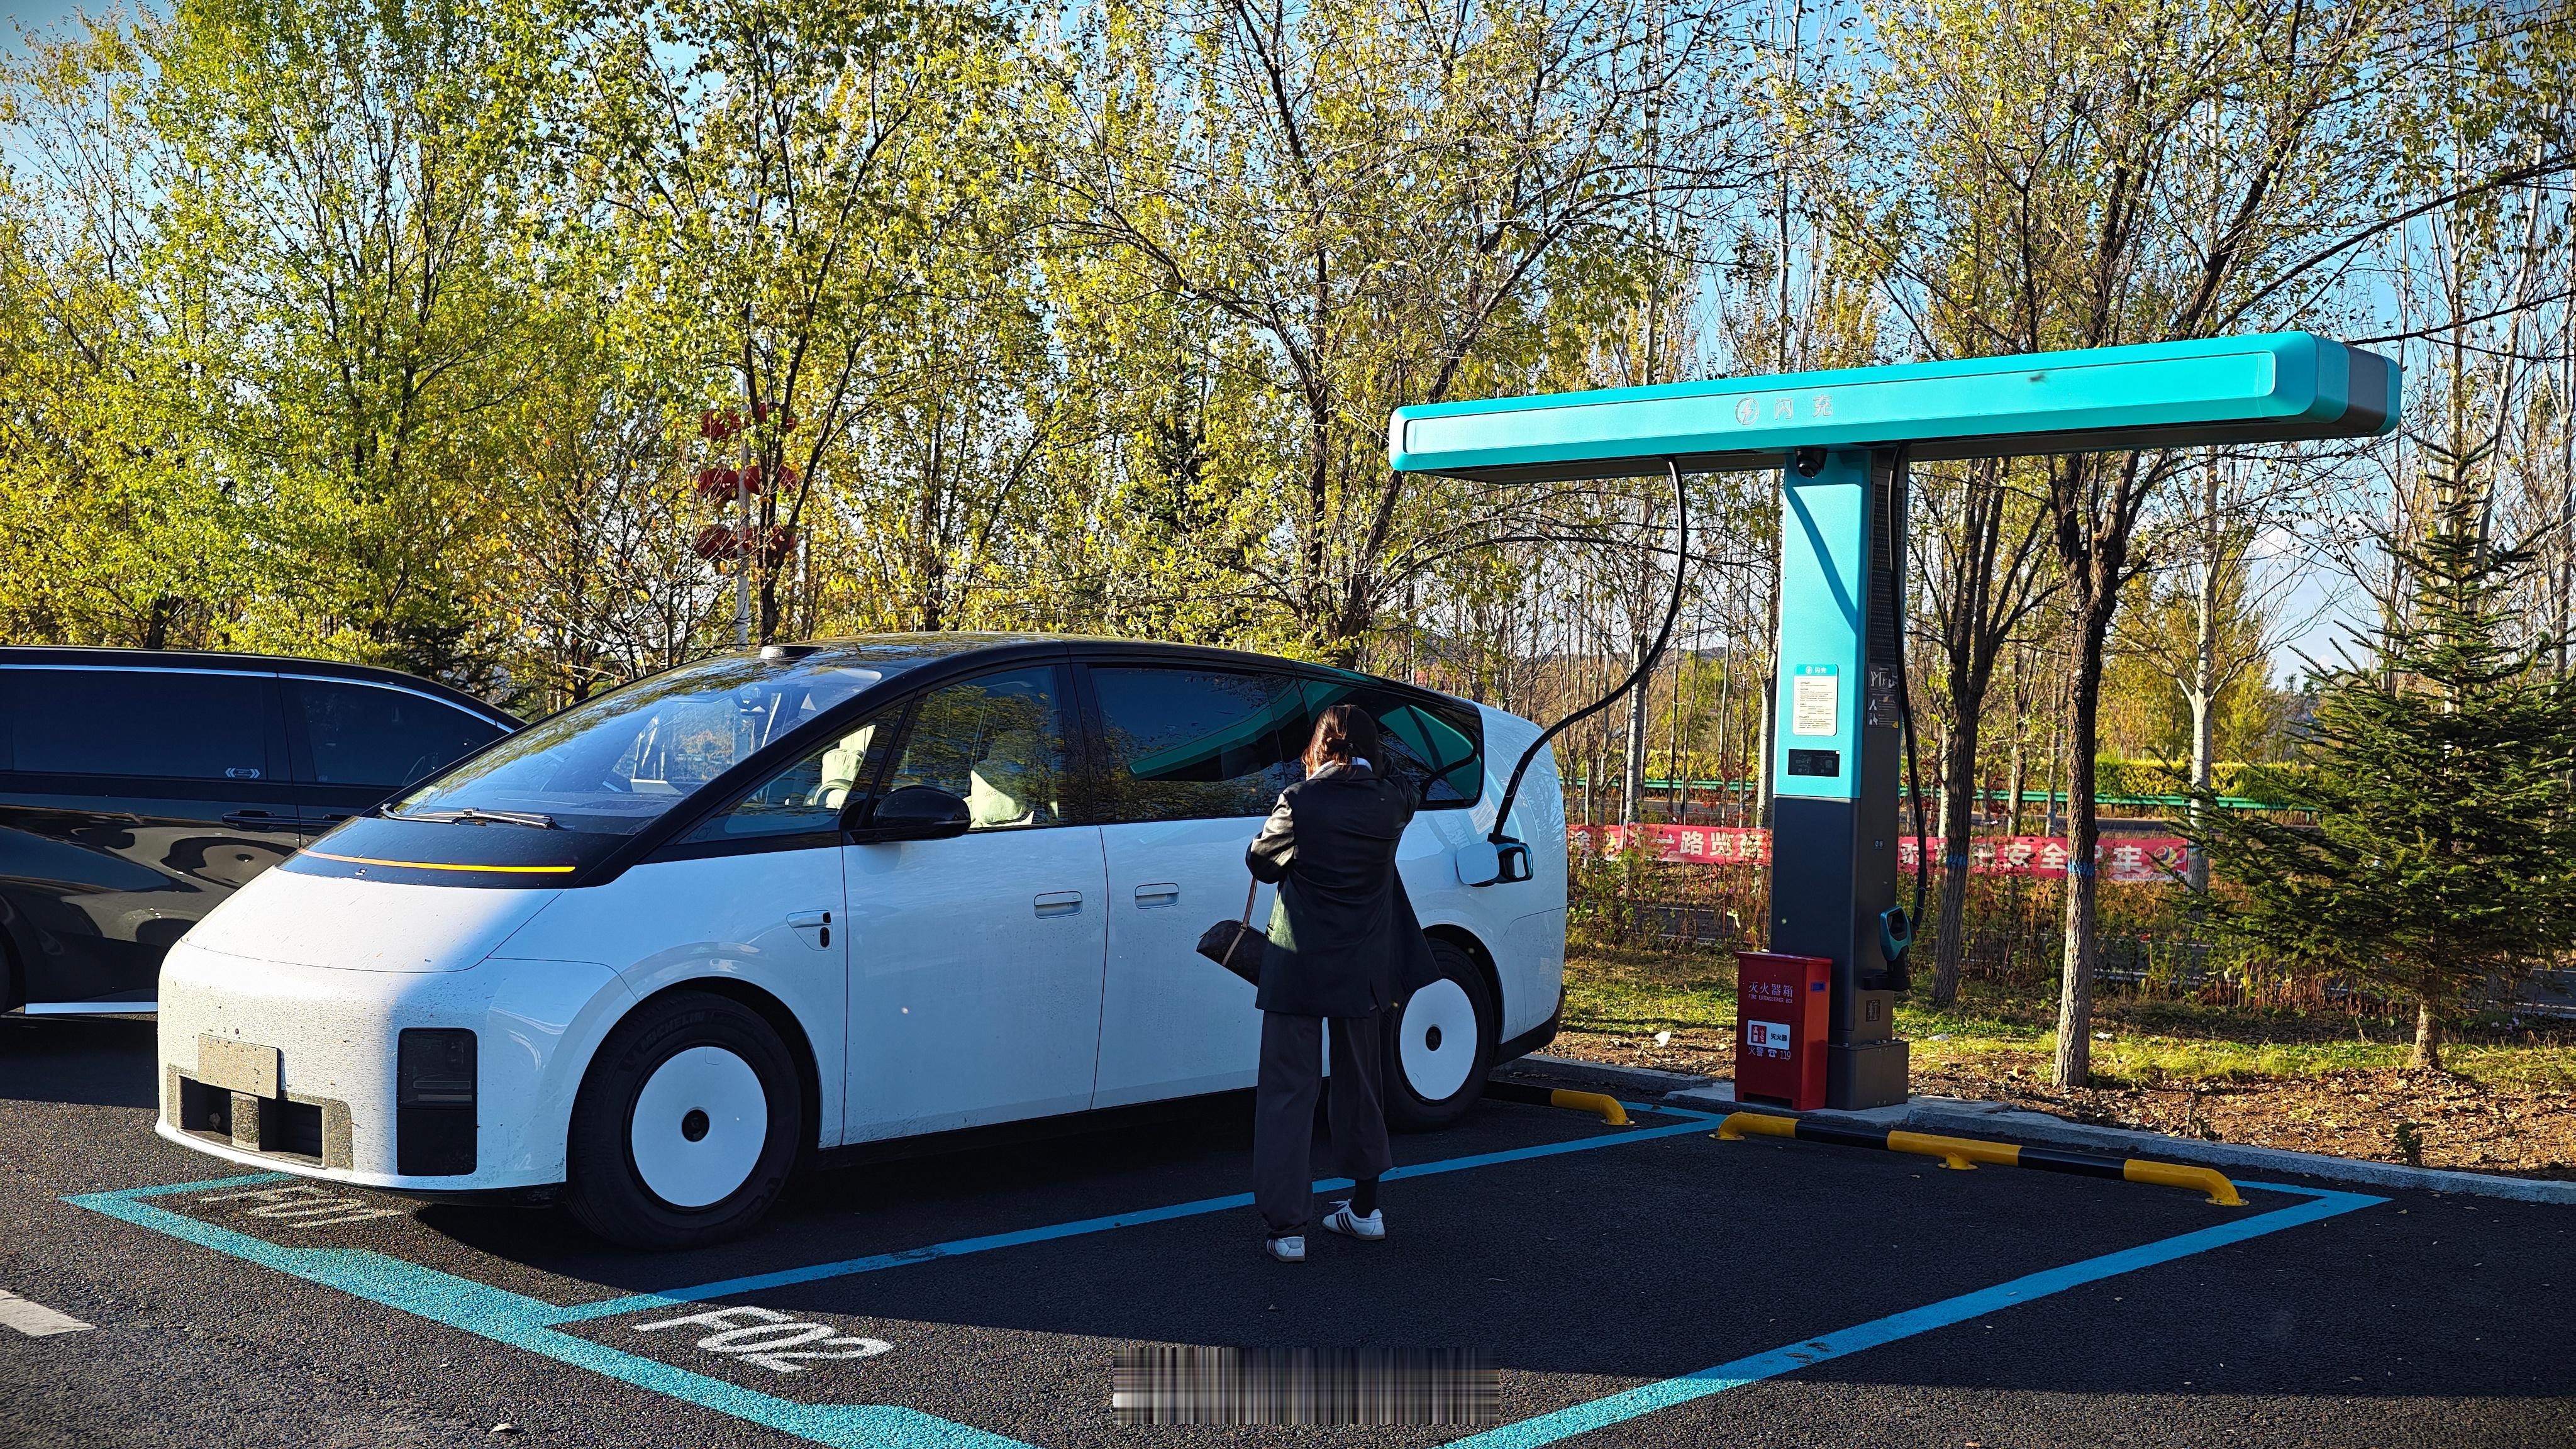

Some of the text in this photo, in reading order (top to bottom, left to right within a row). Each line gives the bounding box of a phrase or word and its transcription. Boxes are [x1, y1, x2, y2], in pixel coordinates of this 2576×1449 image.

[1774, 394, 1834, 421] 闪充
[1748, 981, 1793, 997] 灭火器箱
[641, 1011, 706, 1048] MICHELIN
[1770, 1033, 1787, 1042] 灭火器
[1748, 1046, 1791, 1060] 火警 119
[632, 1305, 894, 1373] F02
